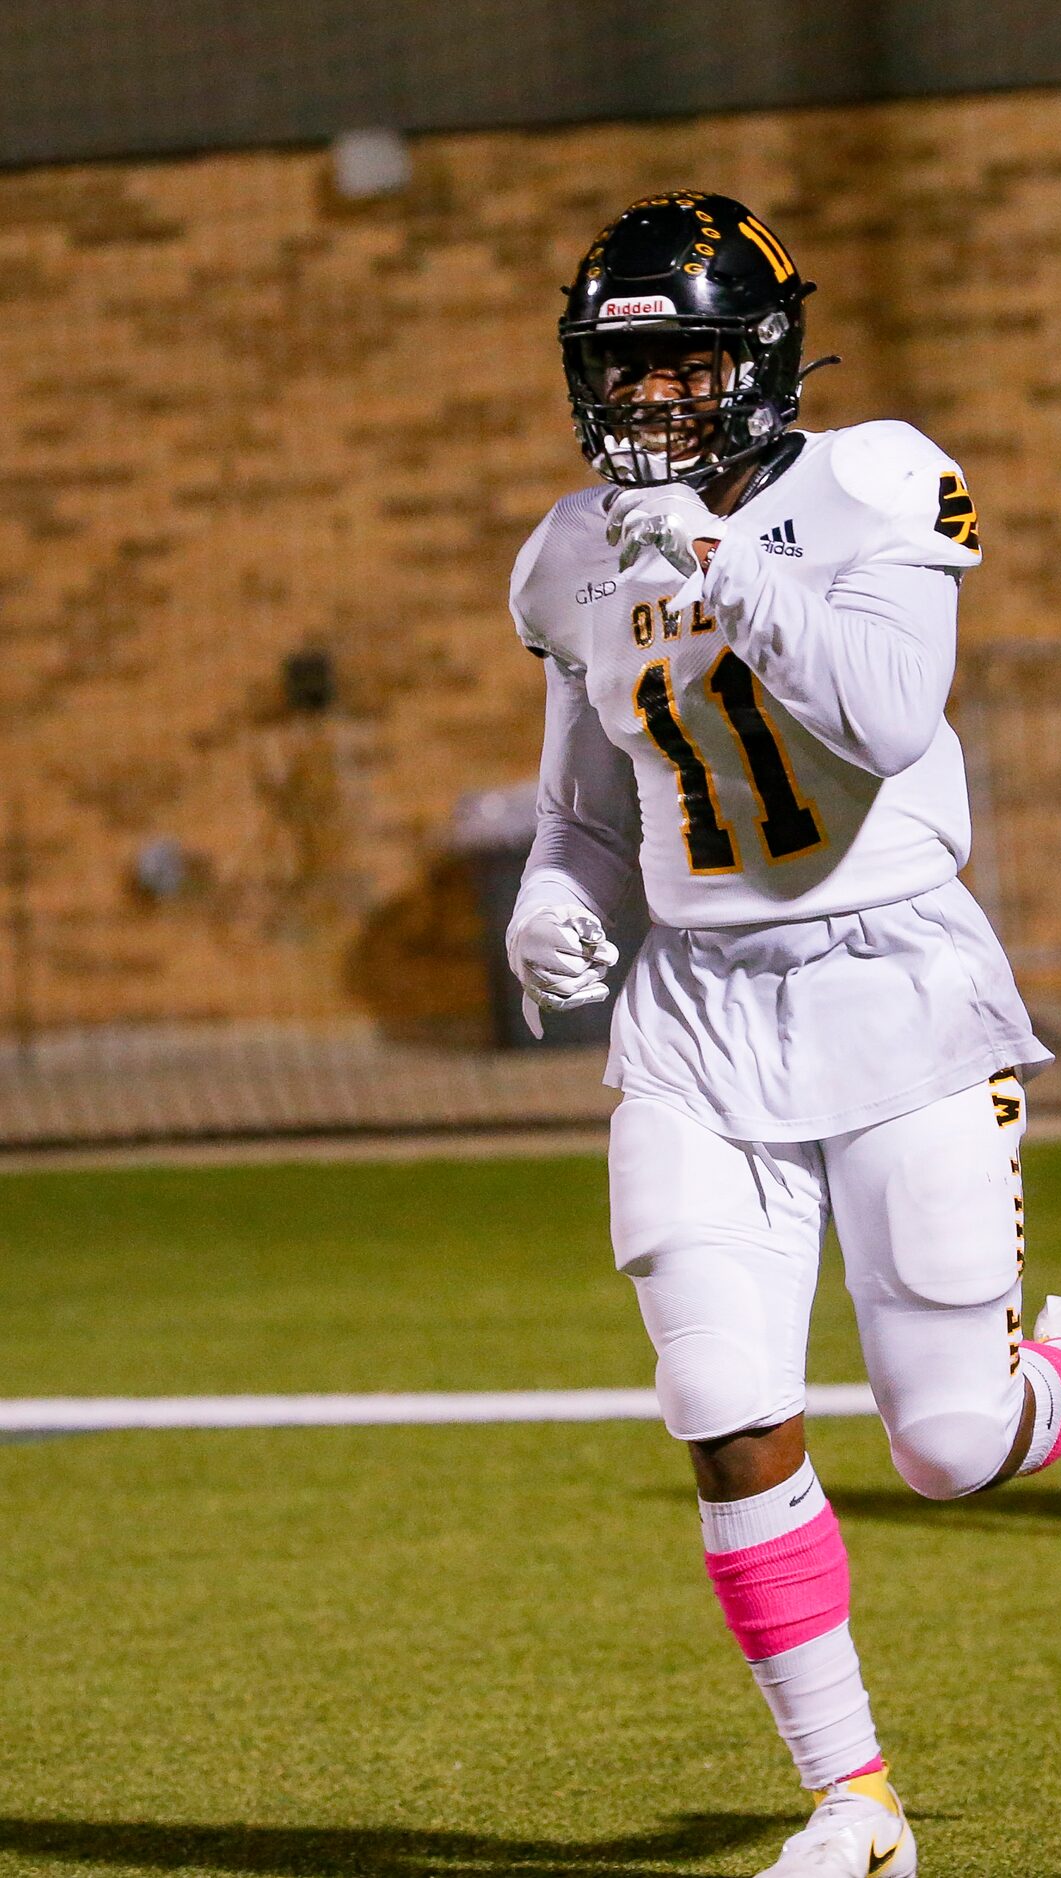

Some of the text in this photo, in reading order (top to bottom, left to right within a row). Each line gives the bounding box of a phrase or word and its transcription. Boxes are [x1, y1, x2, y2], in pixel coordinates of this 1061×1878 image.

[606, 300, 663, 316] Riddell
[631, 595, 718, 650] OWL
[633, 645, 830, 875] 11
